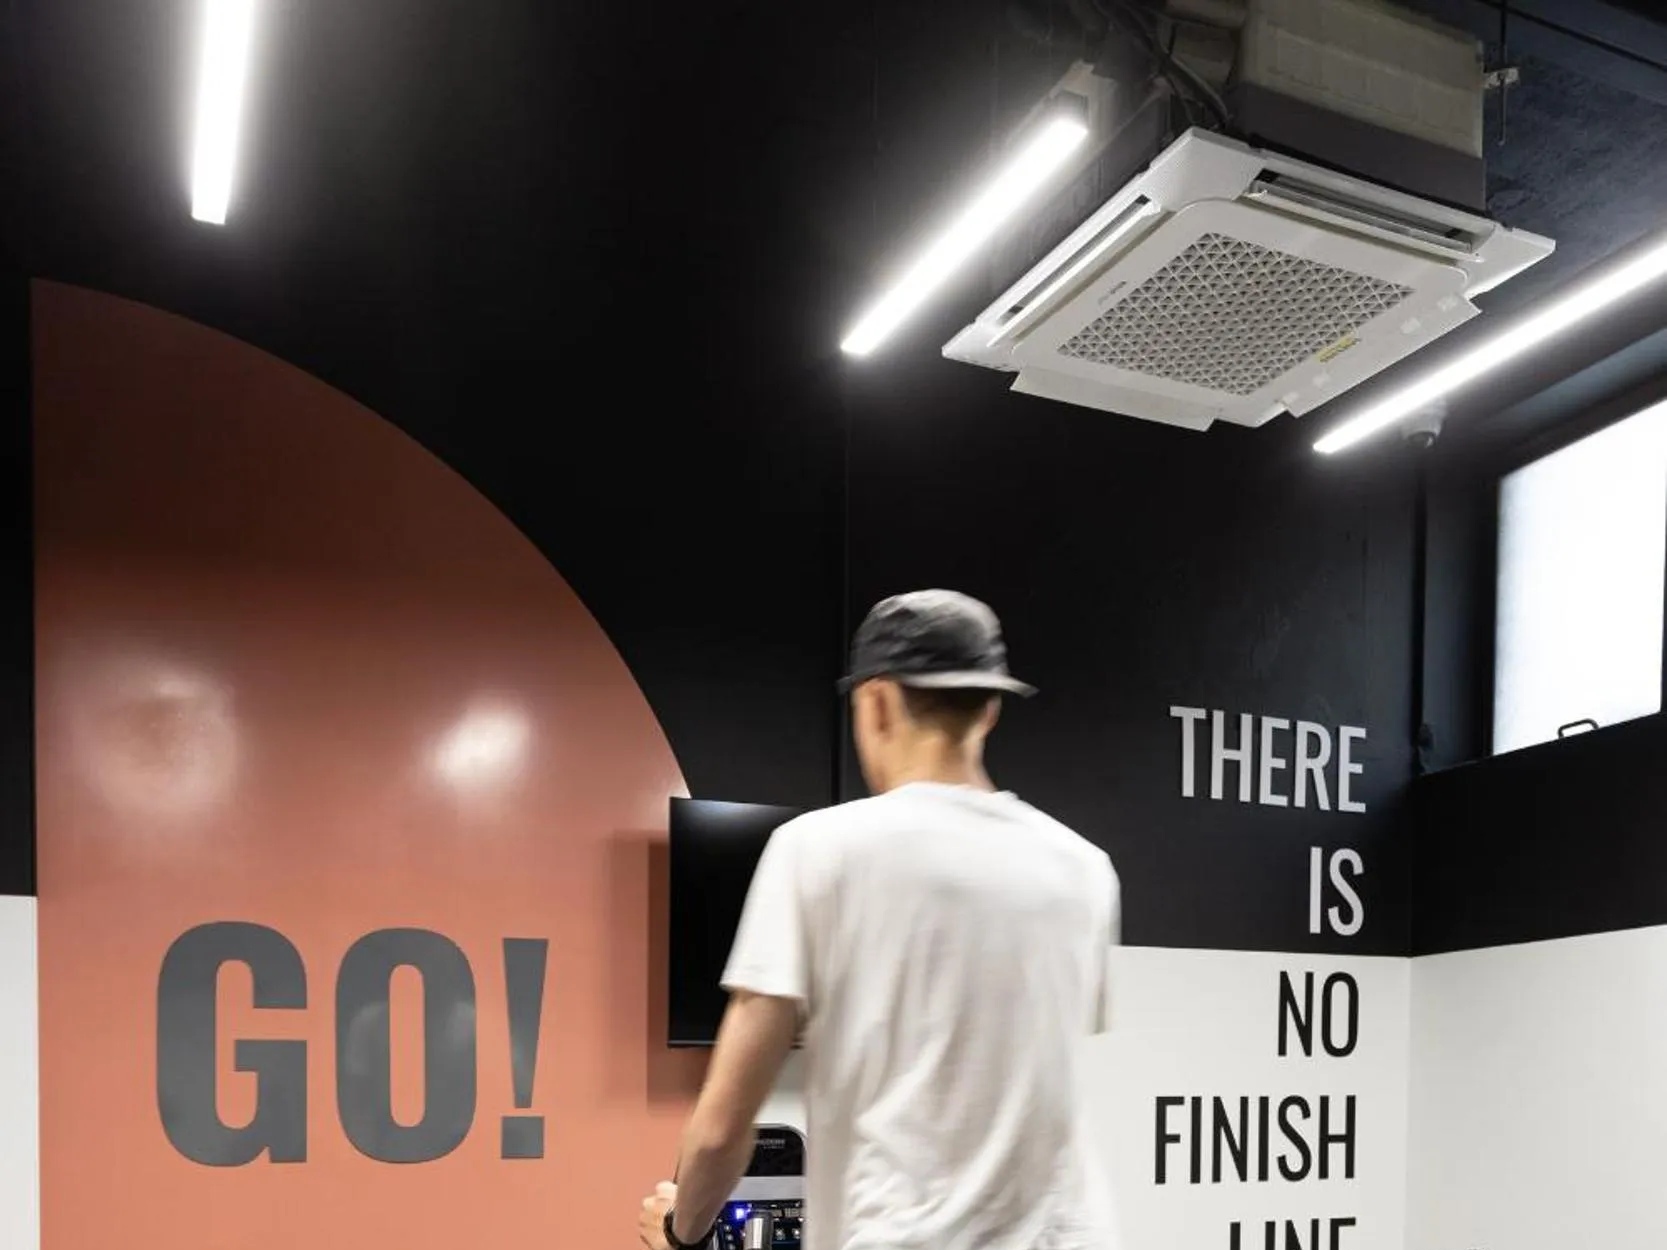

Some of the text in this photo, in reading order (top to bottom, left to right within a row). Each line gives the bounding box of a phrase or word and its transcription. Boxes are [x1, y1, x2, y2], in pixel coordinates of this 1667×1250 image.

[1169, 705, 1367, 813] THERE
[1309, 846, 1365, 936] IS
[156, 920, 549, 1167] GO!
[1277, 970, 1359, 1058] NO
[1154, 1094, 1356, 1185] FINISH
